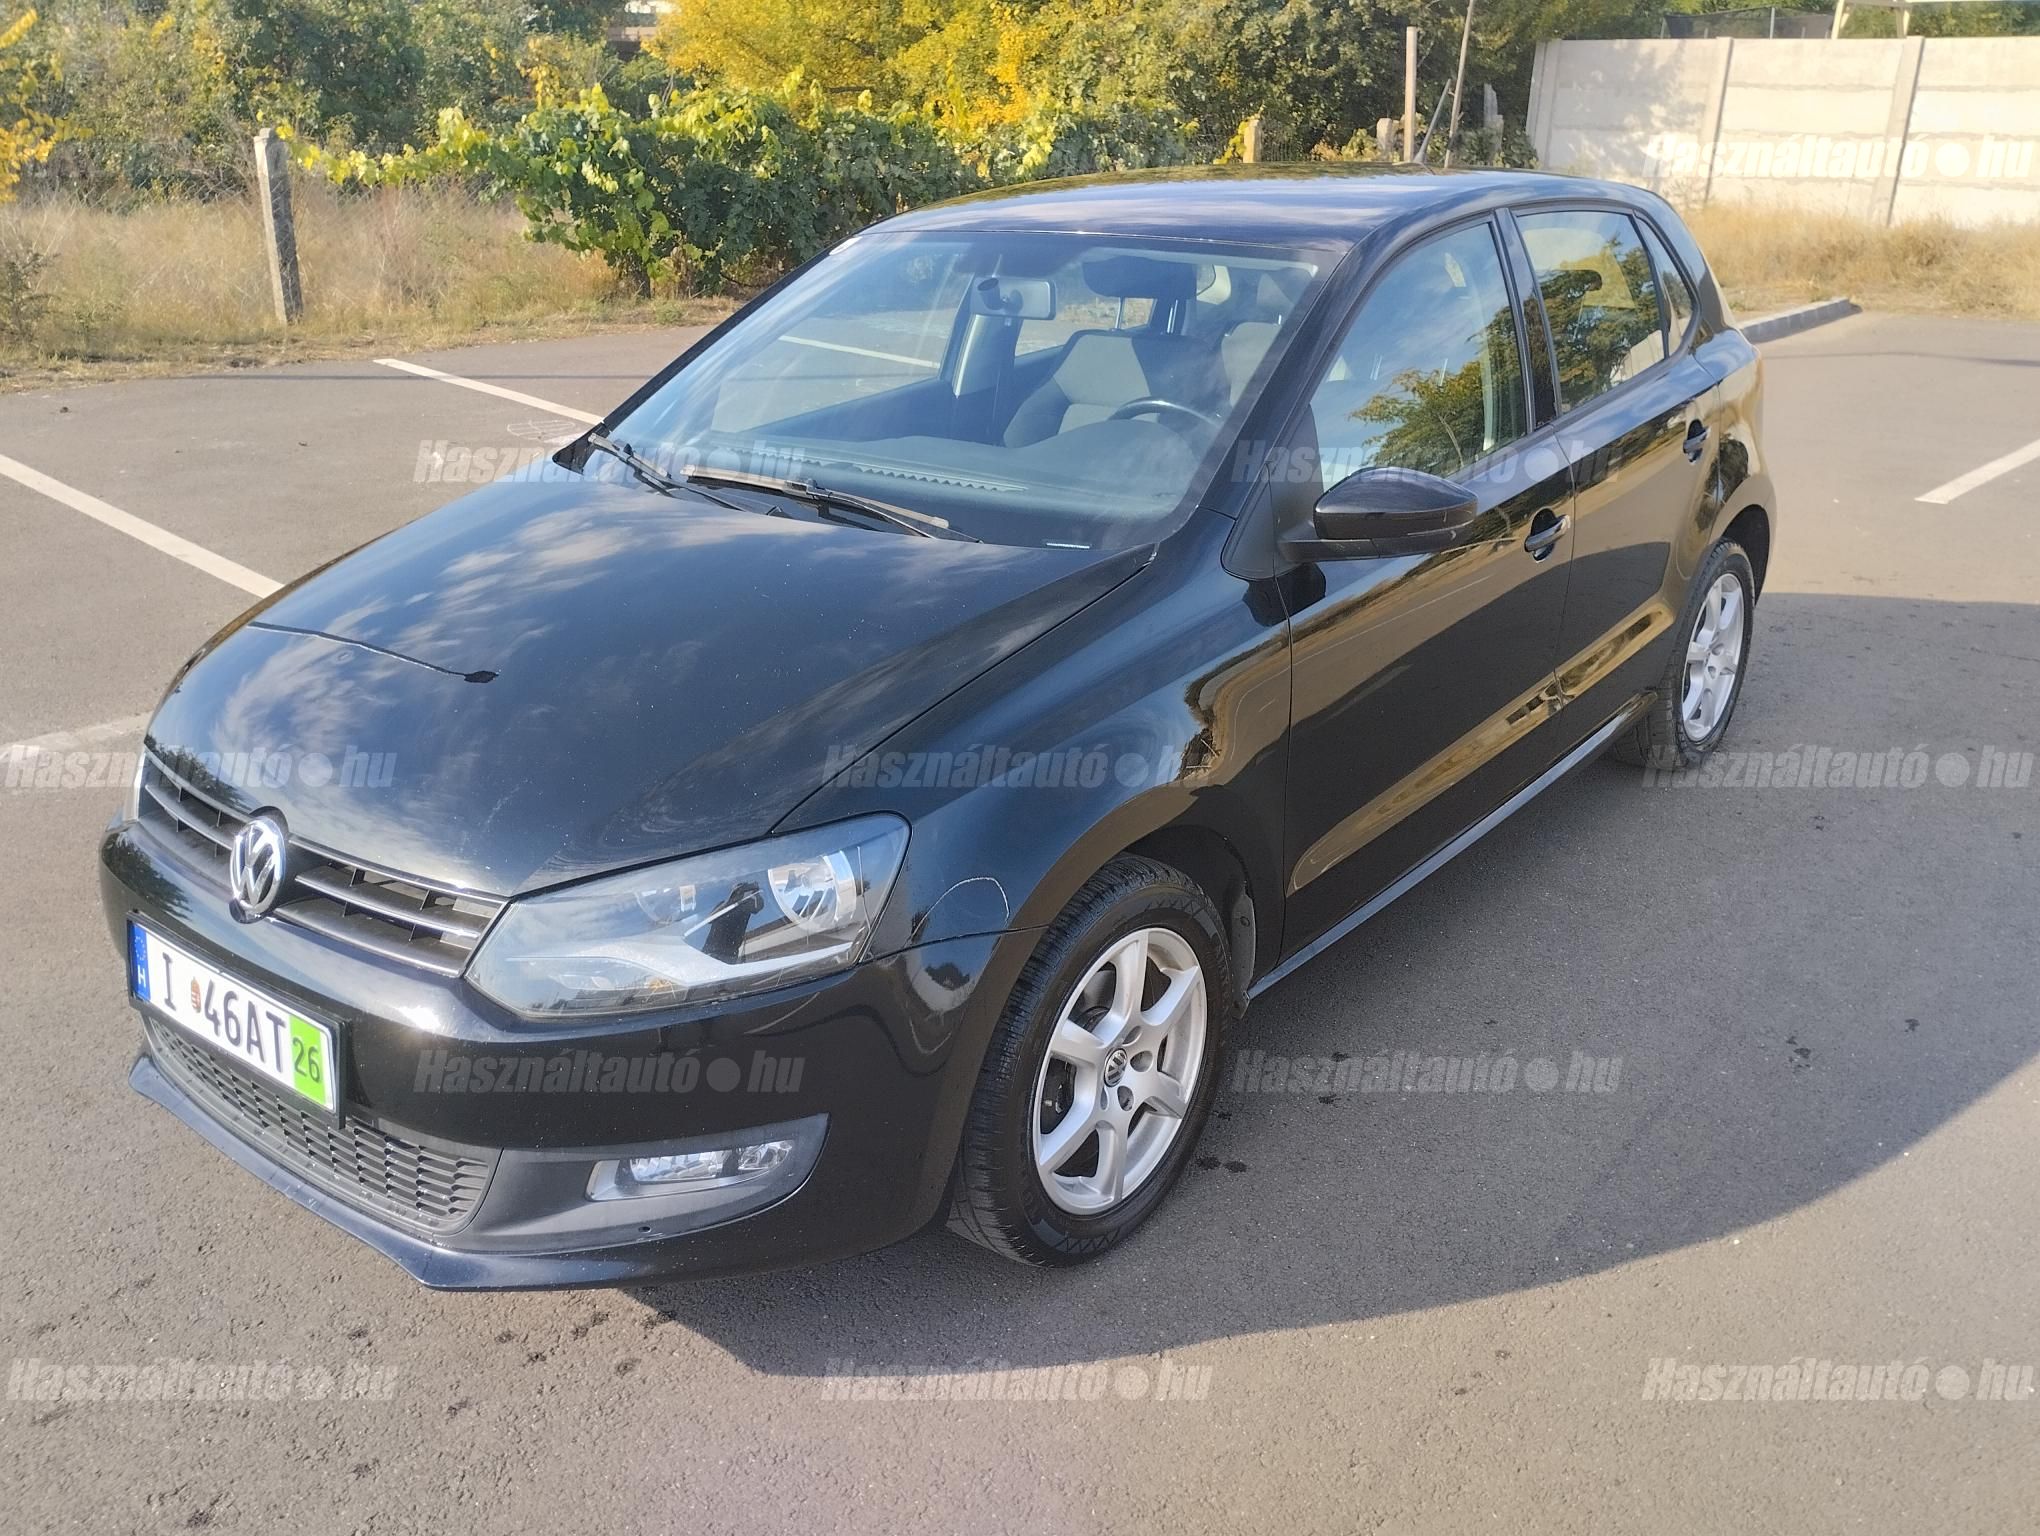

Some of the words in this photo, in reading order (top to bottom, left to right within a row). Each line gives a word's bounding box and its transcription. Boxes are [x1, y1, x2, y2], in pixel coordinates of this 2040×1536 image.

[137, 963, 147, 988] H
[162, 952, 176, 1011] I
[203, 979, 287, 1073] 46AT
[292, 1036, 321, 1083] 26
